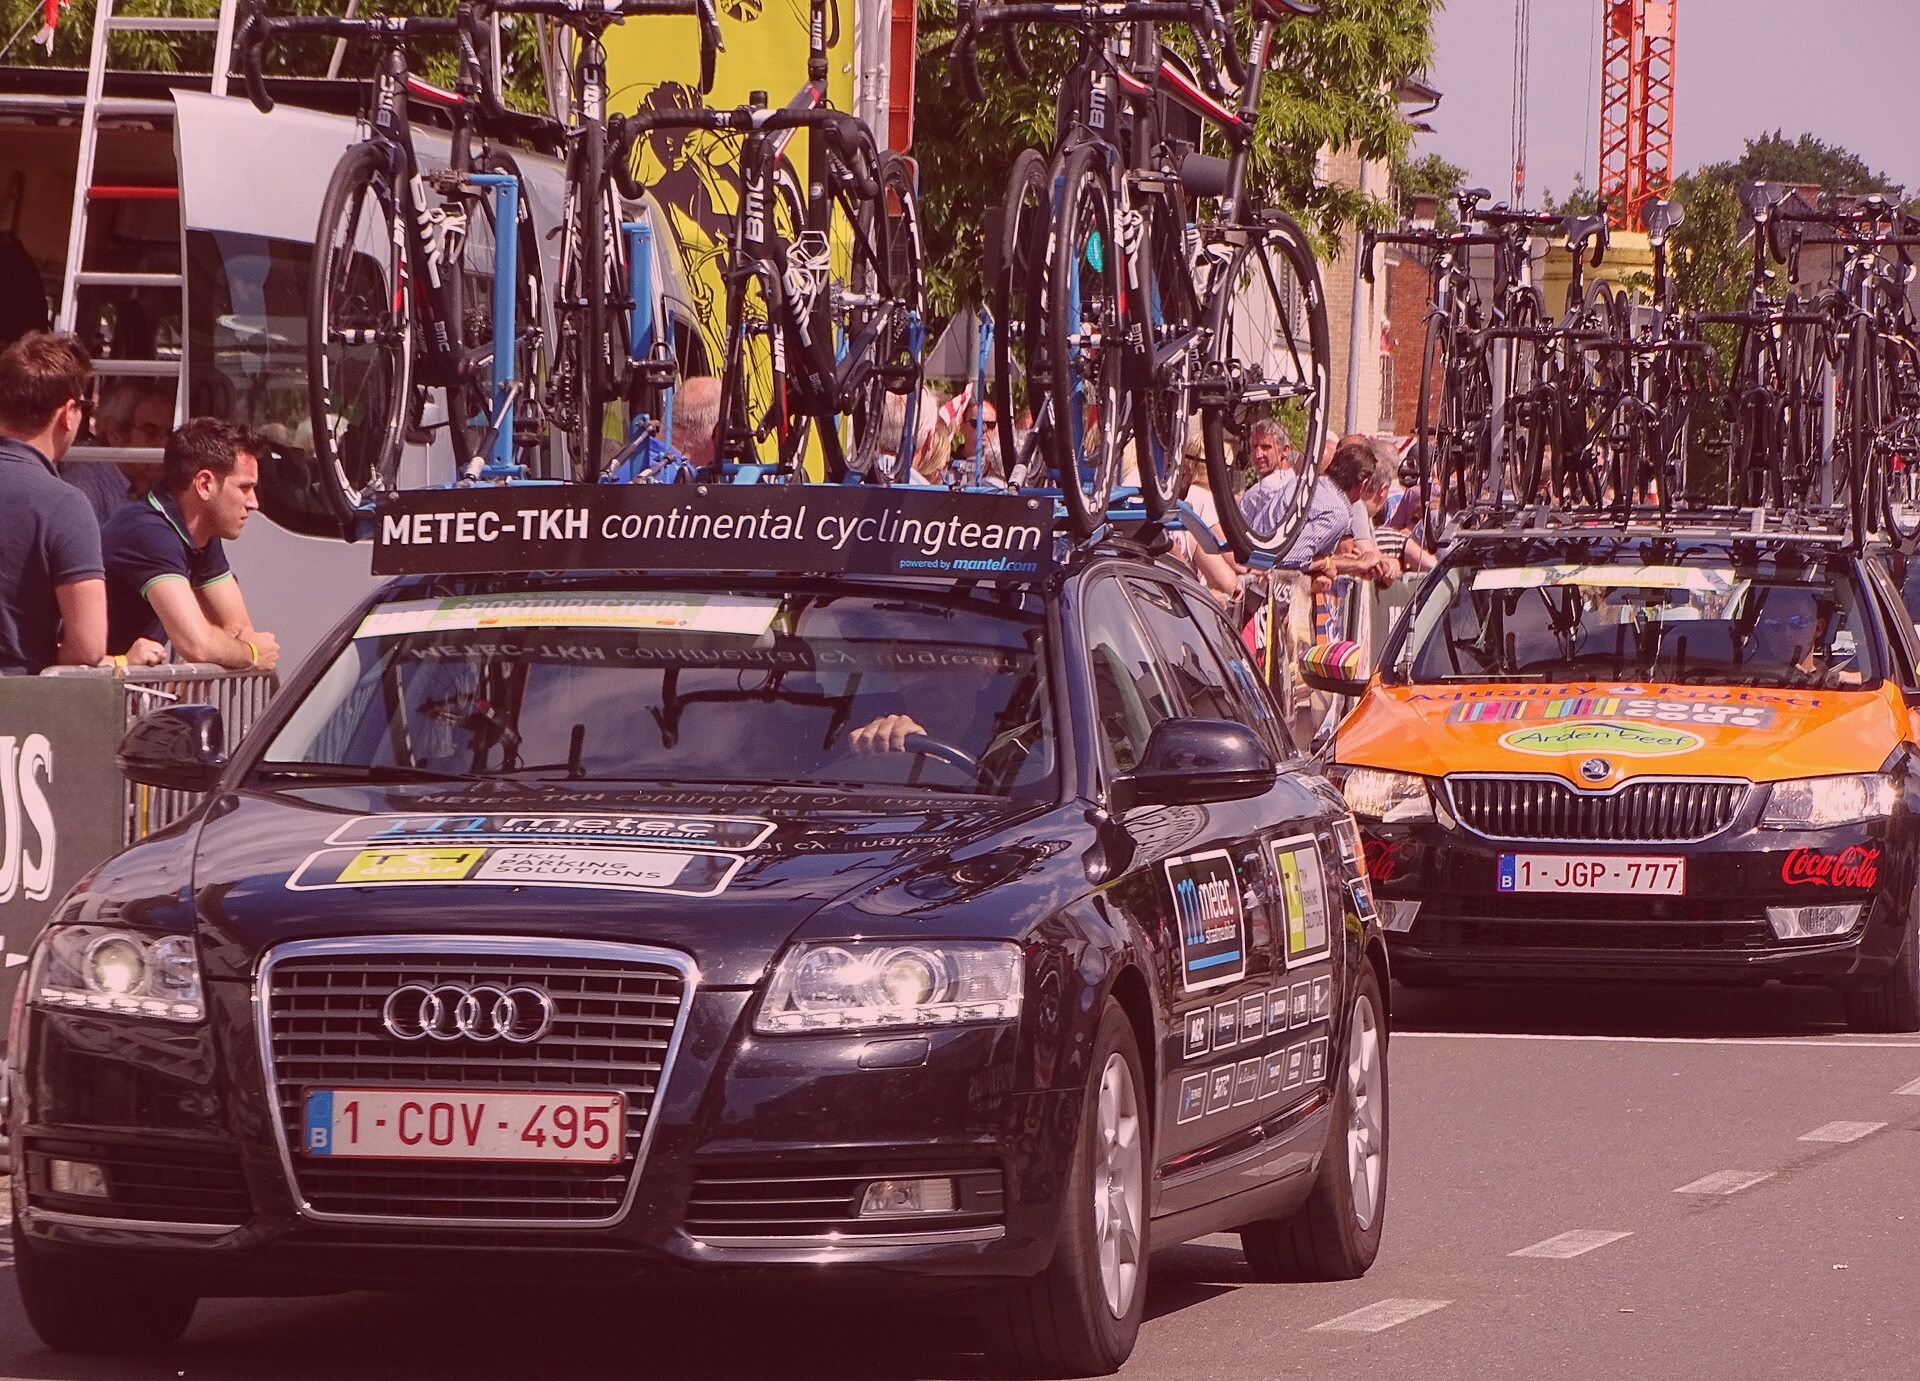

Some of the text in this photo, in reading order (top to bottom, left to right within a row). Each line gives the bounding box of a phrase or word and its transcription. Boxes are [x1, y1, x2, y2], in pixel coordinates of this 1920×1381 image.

[812, 9, 823, 51] BMC
[377, 74, 395, 128] BMC
[1089, 70, 1107, 129] BMC
[745, 167, 765, 244] BMC
[381, 504, 1042, 556] METEC-TKH continental cyclingteam
[899, 556, 1038, 573] powered by mantel.com
[448, 598, 687, 619] SPORTDIRECTEUR
[1623, 708, 1761, 727] code
[1626, 699, 1766, 717] color
[500, 816, 716, 833] metec
[500, 858, 630, 869] PARKING
[509, 852, 568, 862] TKH
[1781, 844, 1881, 888] Coca-Cola
[493, 865, 662, 880] SOLUTIONS
[1501, 875, 1513, 888] B
[1198, 871, 1235, 922] metec
[310, 1127, 328, 1149] B
